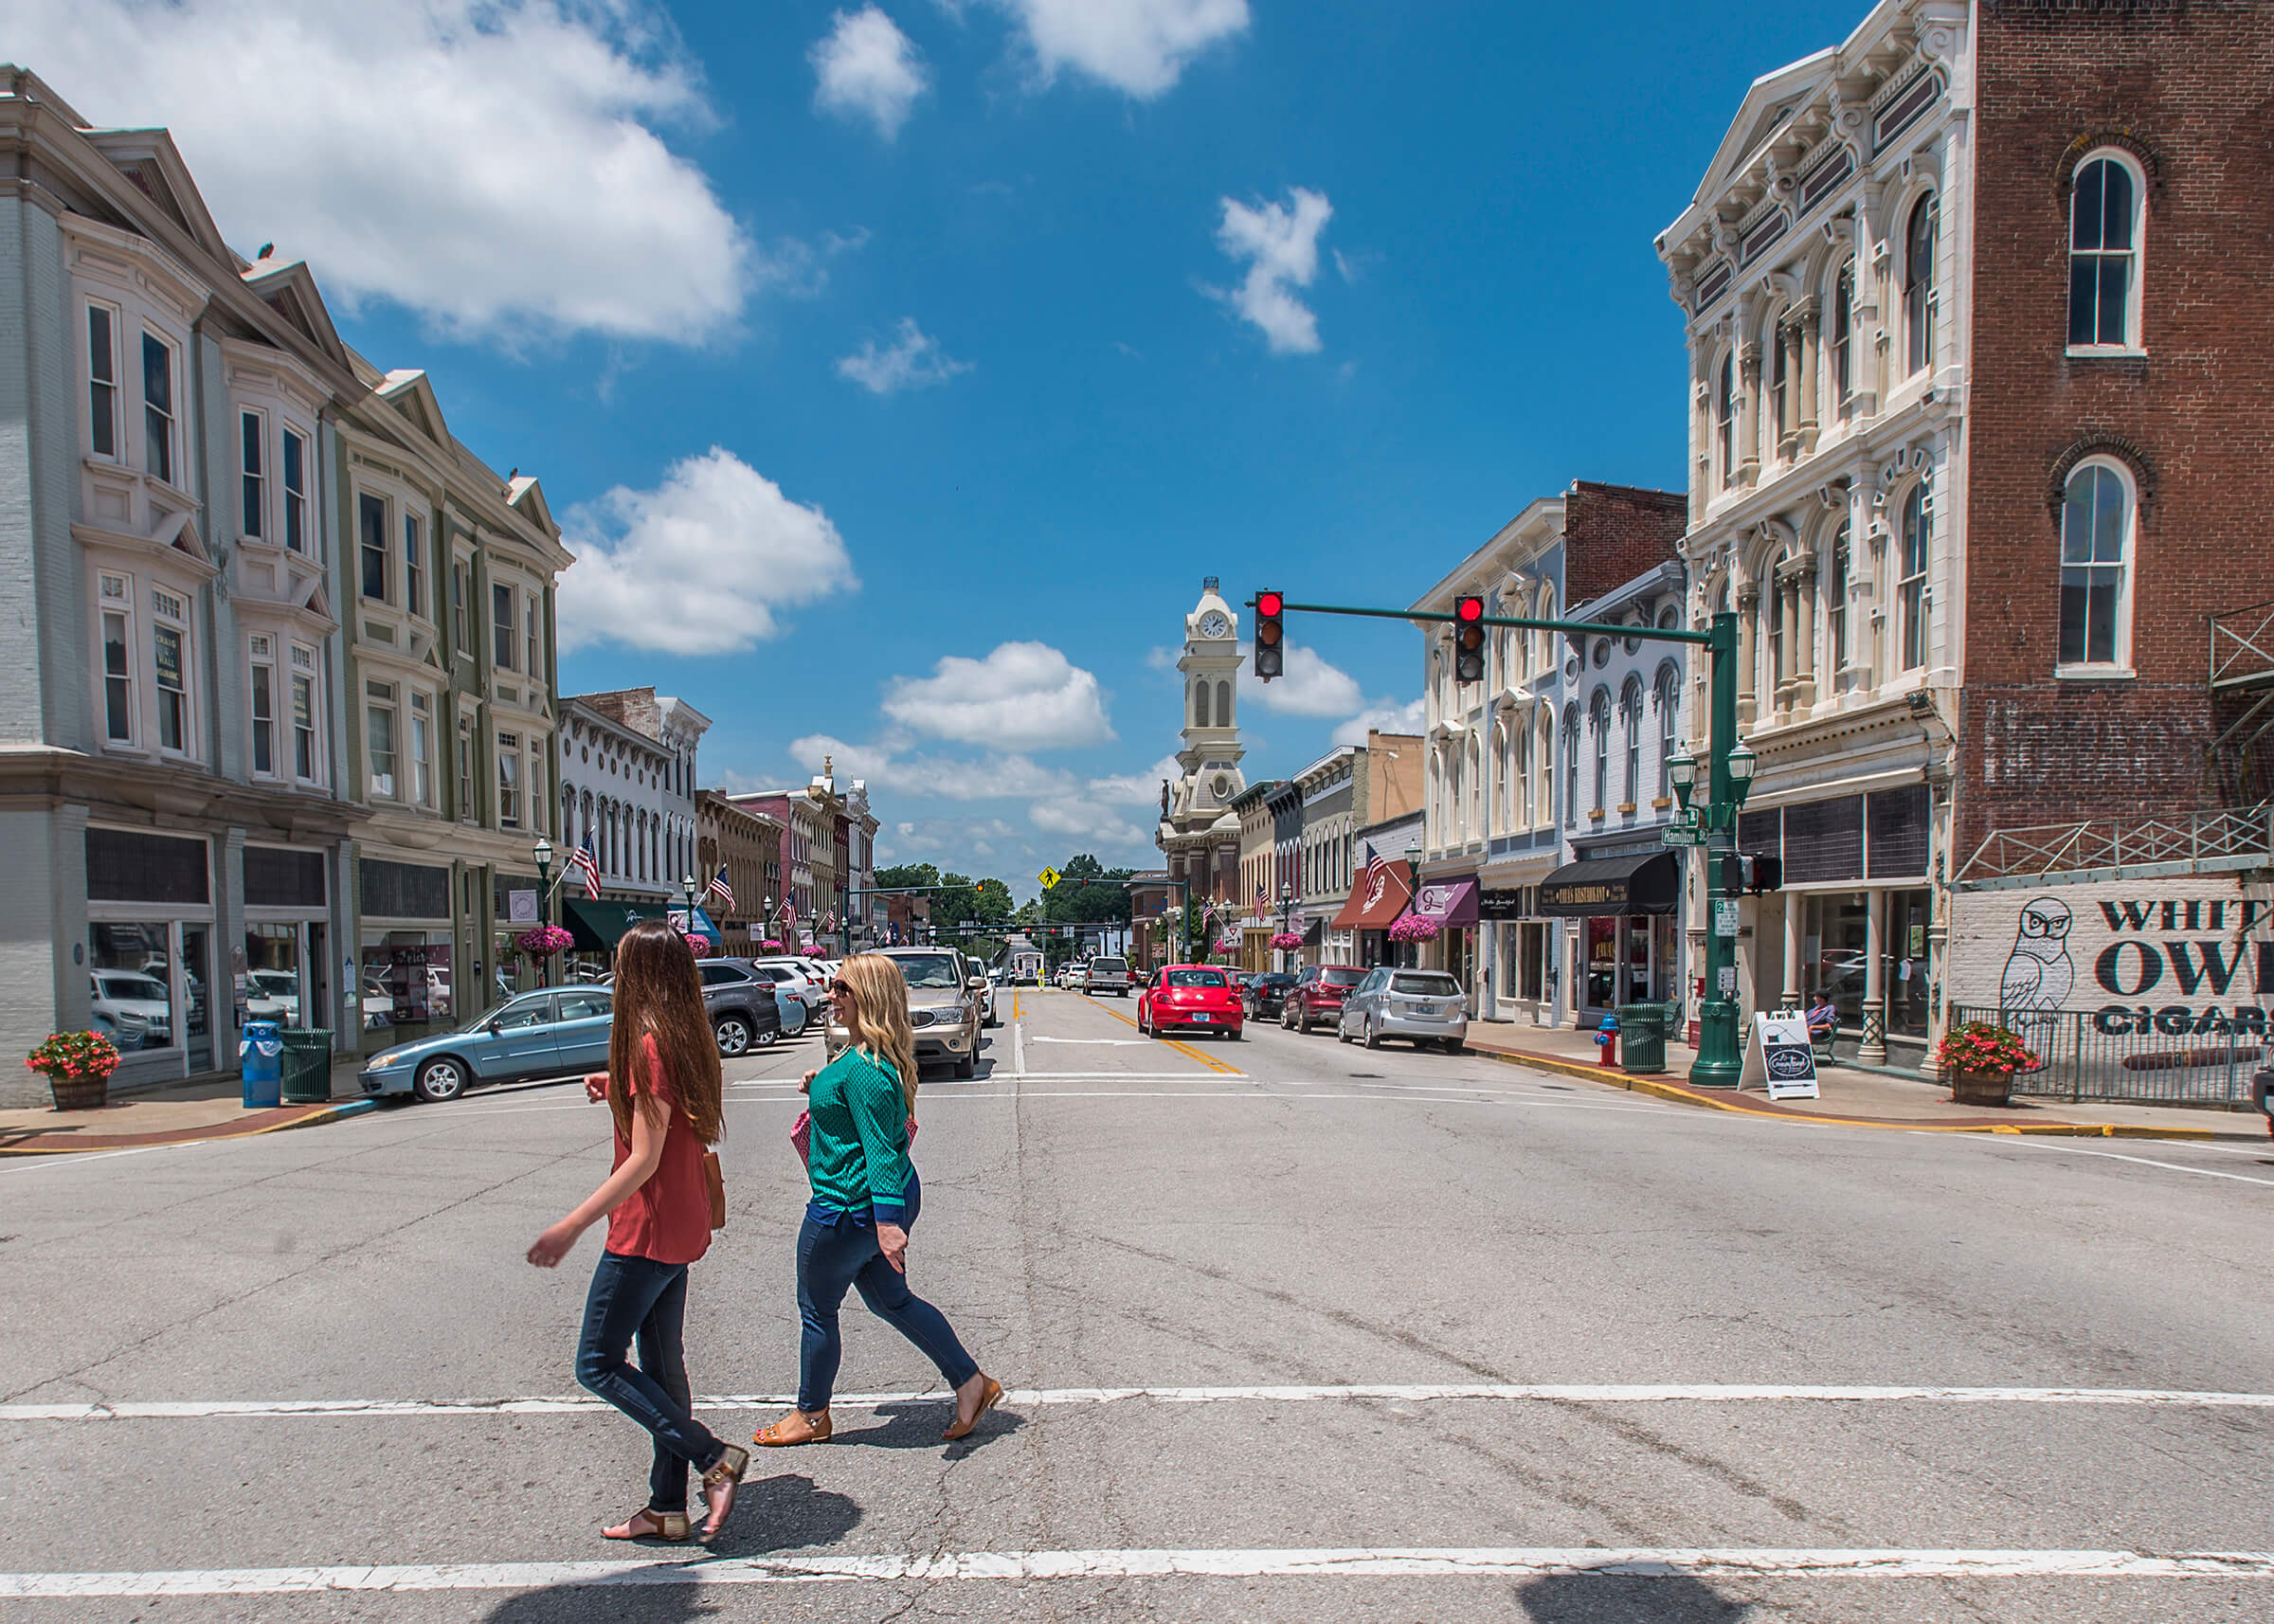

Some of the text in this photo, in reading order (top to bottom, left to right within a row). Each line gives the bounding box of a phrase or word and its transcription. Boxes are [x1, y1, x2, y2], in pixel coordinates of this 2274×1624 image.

[1664, 828, 1695, 844] Hamilton
[1717, 902, 1724, 911] 2
[2097, 899, 2274, 932] WHIT
[2093, 1005, 2274, 1036] CIGAR
